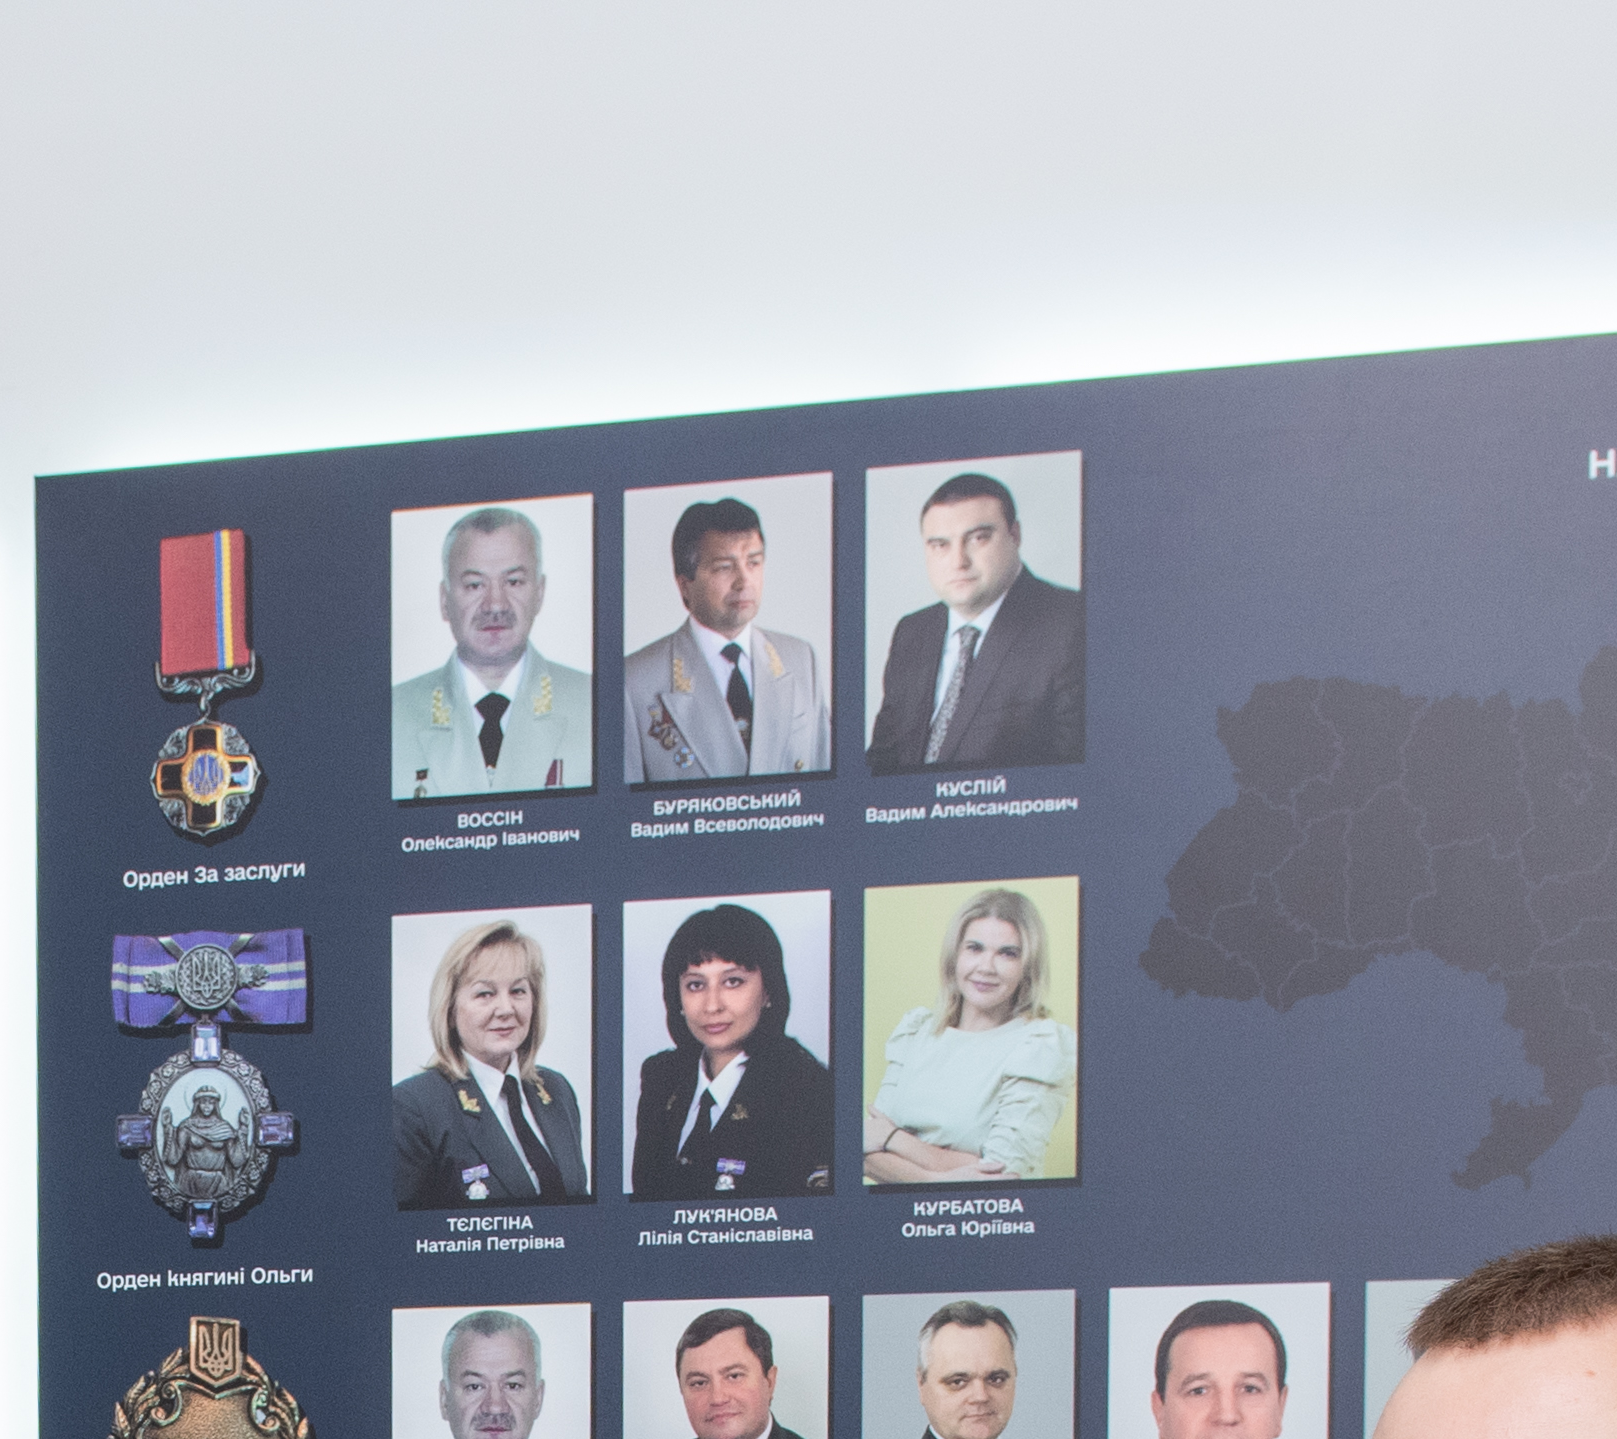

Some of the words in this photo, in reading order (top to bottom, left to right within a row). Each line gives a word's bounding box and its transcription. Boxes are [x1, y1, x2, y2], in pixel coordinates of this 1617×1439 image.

[936, 775, 1006, 797] КУСЛІЙ
[654, 789, 801, 816] БУРЯКОВСЬКИЙ
[866, 806, 926, 823] Вадим
[930, 797, 1078, 819] Александрович
[458, 810, 523, 829] ВОССІН
[631, 821, 689, 838] Вадим
[694, 813, 824, 834] Всеволодович
[401, 833, 498, 852] Олександр
[502, 829, 580, 846] Іванович
[123, 870, 188, 890] Орден
[195, 865, 219, 884] За
[224, 862, 305, 883] заслуги
[673, 1206, 778, 1224] ЛУК'ЯНОВА
[914, 1198, 1023, 1216] КУРБАТОВА
[447, 1215, 533, 1232] ТЄЛЄГІНА
[902, 1222, 956, 1237] Ольга
[962, 1218, 1035, 1238] Юріївна
[416, 1236, 481, 1253] Наталія
[487, 1234, 565, 1253] Петрівна
[638, 1230, 682, 1246] Лілія
[687, 1226, 813, 1245] Станіславівна
[97, 1271, 161, 1293] Орден
[168, 1266, 244, 1287] княгині
[251, 1267, 313, 1284] Ольги
